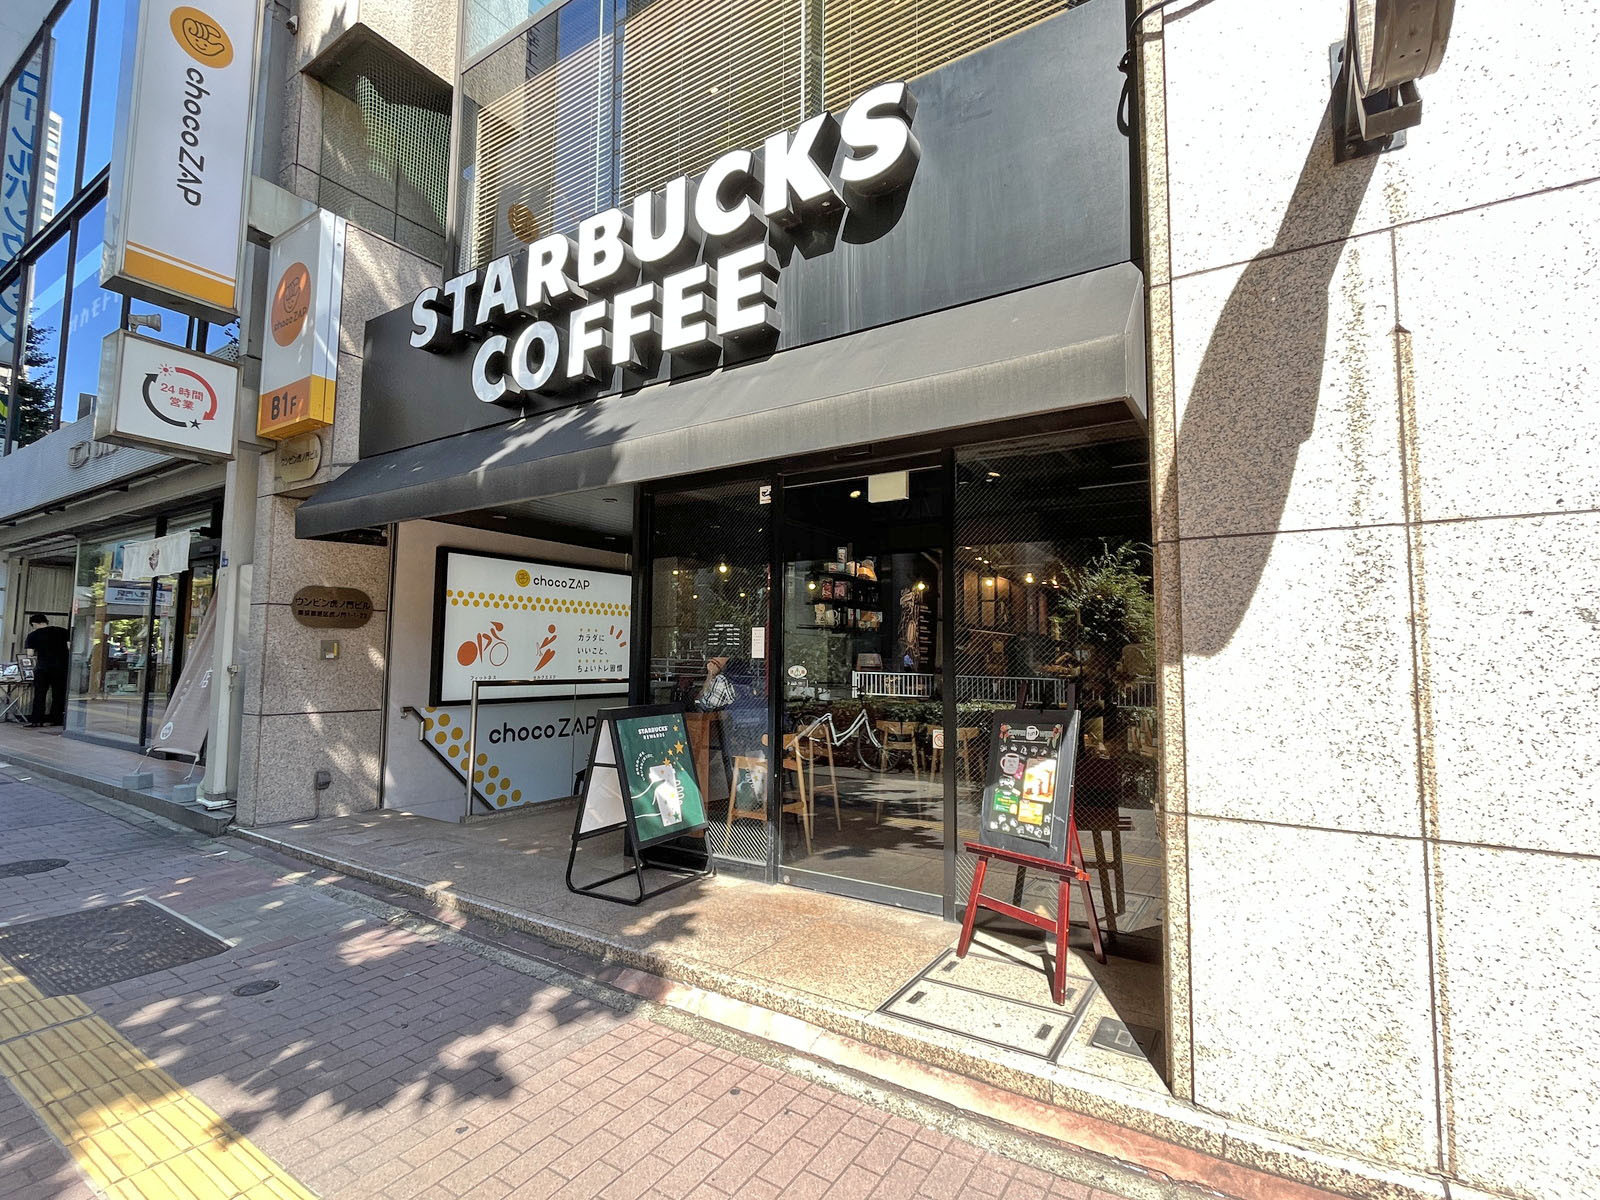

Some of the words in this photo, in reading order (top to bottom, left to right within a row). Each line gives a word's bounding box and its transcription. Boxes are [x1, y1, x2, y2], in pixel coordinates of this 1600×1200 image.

[177, 67, 210, 206] chocoZAP
[408, 80, 914, 350] STARBUCKS
[471, 243, 770, 403] COFFEE
[169, 396, 195, 411] 営業
[271, 391, 297, 420] B1F
[533, 575, 590, 590] chocoZAP
[578, 633, 605, 642] カラダに
[489, 715, 596, 744] chocoZAP
[638, 725, 668, 735] STARBUCKS
[643, 732, 665, 740] REWARDS
